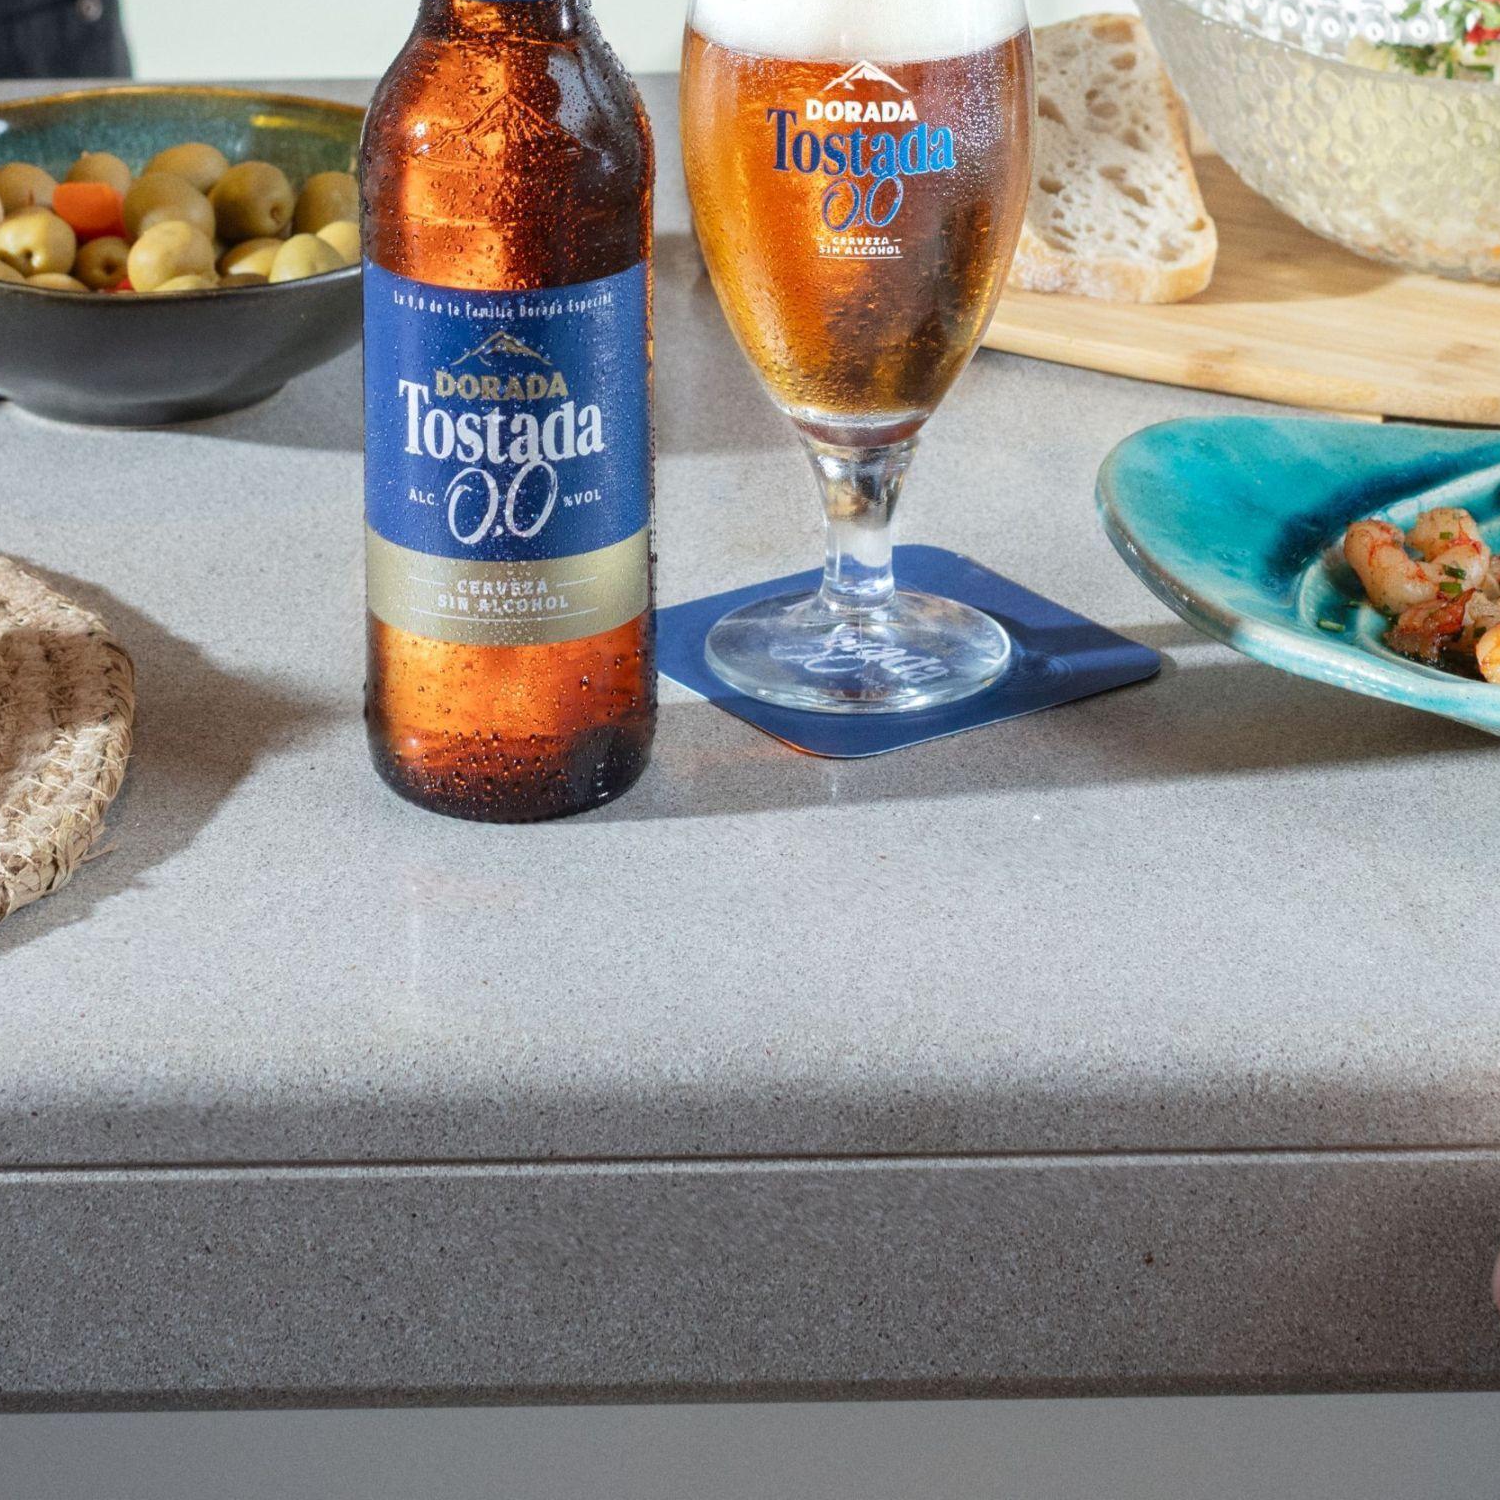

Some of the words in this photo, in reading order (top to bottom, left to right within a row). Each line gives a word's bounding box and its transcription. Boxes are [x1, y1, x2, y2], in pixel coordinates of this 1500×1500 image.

[806, 99, 918, 122] DORADA
[766, 108, 957, 177] Tostada
[819, 246, 840, 255] SIN
[844, 246, 901, 256] ALCOHOL
[832, 237, 889, 246] CERVEZA
[393, 290, 404, 305] La
[430, 300, 443, 314] de
[448, 302, 460, 317] la
[520, 302, 563, 318] Dorada
[435, 370, 569, 402] DORADA
[399, 378, 605, 465] Tostada
[563, 488, 602, 508] %VOL
[456, 578, 549, 597] CERVEZA
[437, 594, 469, 611] SIN
[477, 596, 569, 613] ALCOHOL
